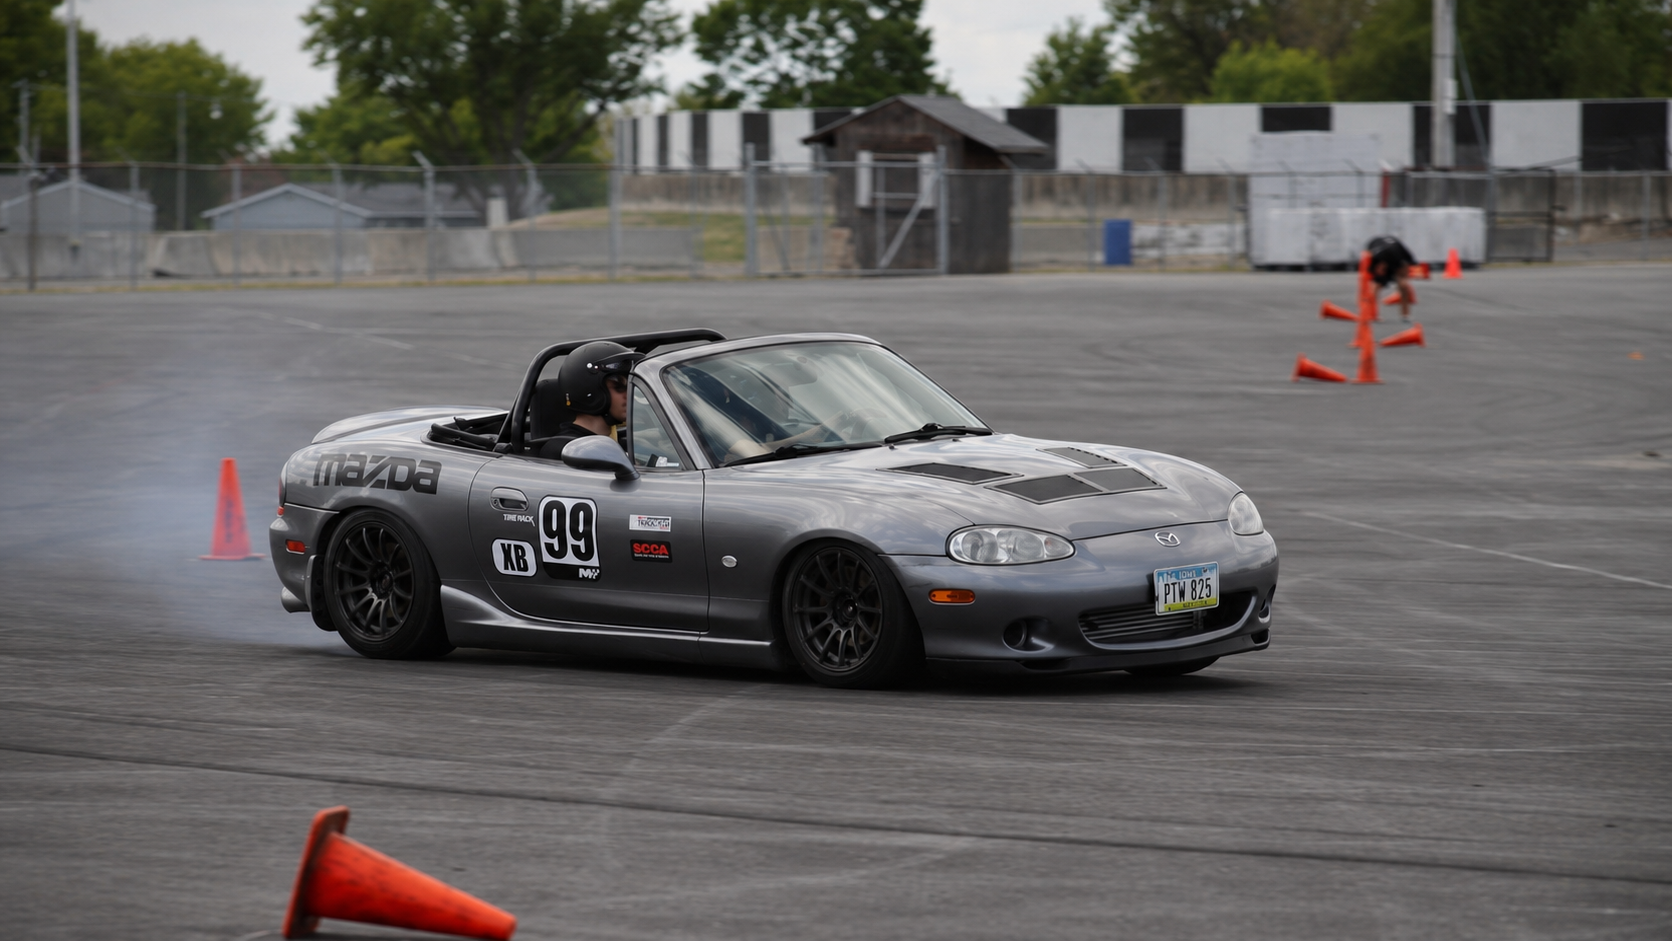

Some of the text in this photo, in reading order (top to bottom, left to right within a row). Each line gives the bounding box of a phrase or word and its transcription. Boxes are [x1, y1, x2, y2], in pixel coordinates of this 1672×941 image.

[543, 500, 595, 562] 99
[500, 542, 529, 573] XB
[633, 542, 669, 556] SCCA
[1164, 577, 1211, 604] PTW 825
